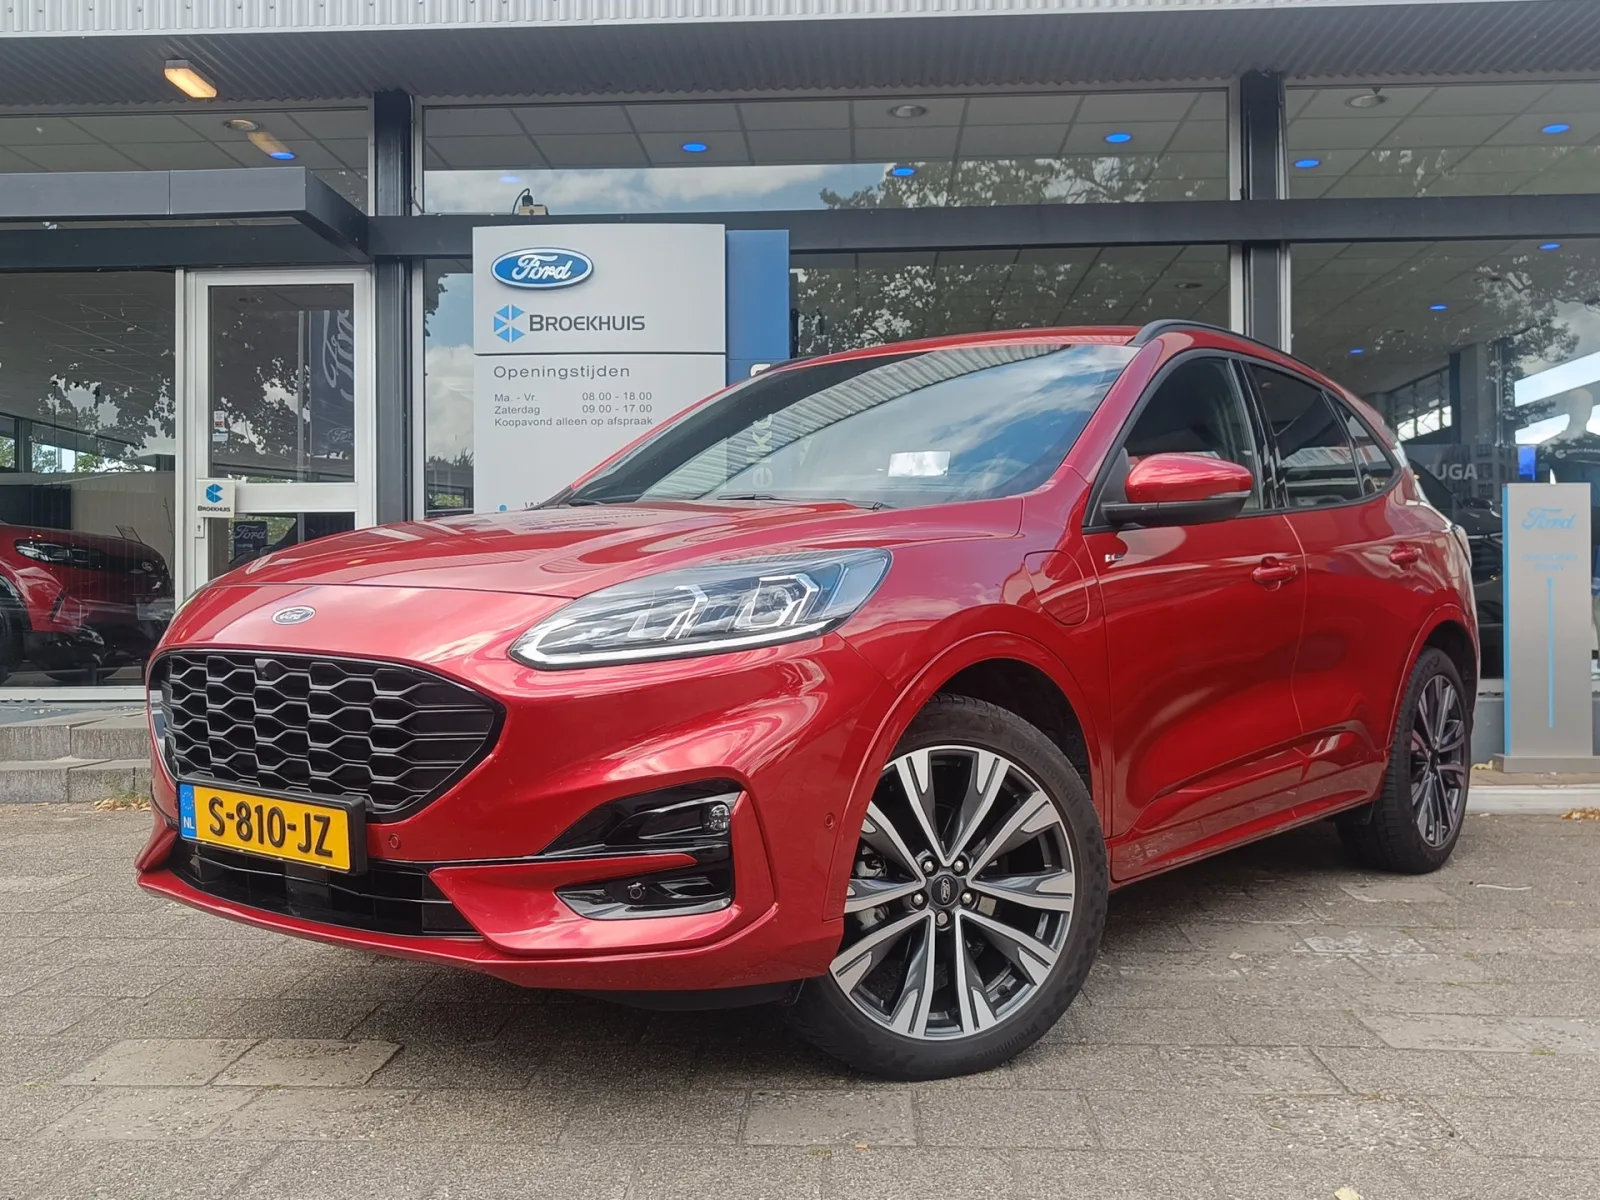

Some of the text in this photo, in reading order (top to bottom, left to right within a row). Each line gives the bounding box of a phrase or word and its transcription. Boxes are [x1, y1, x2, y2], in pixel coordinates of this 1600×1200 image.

[511, 254, 573, 280] Ford
[529, 314, 645, 332] BROEKHUIS
[493, 365, 630, 380] Openingstijden
[494, 393, 513, 402] Ma.
[523, 393, 538, 402] Vr.
[582, 392, 612, 401] 08.00
[623, 391, 653, 401] 18.00
[494, 405, 541, 416] Zaterdag
[582, 404, 612, 413] 09.00
[623, 404, 653, 413] 17.00
[494, 416, 653, 428] Koopavond alleen op afspraak
[1424, 463, 1479, 481] UGA
[1521, 507, 1578, 530] Ford
[234, 524, 267, 539] Ford
[183, 816, 195, 829] NL
[208, 796, 333, 858] S-810-JZ
